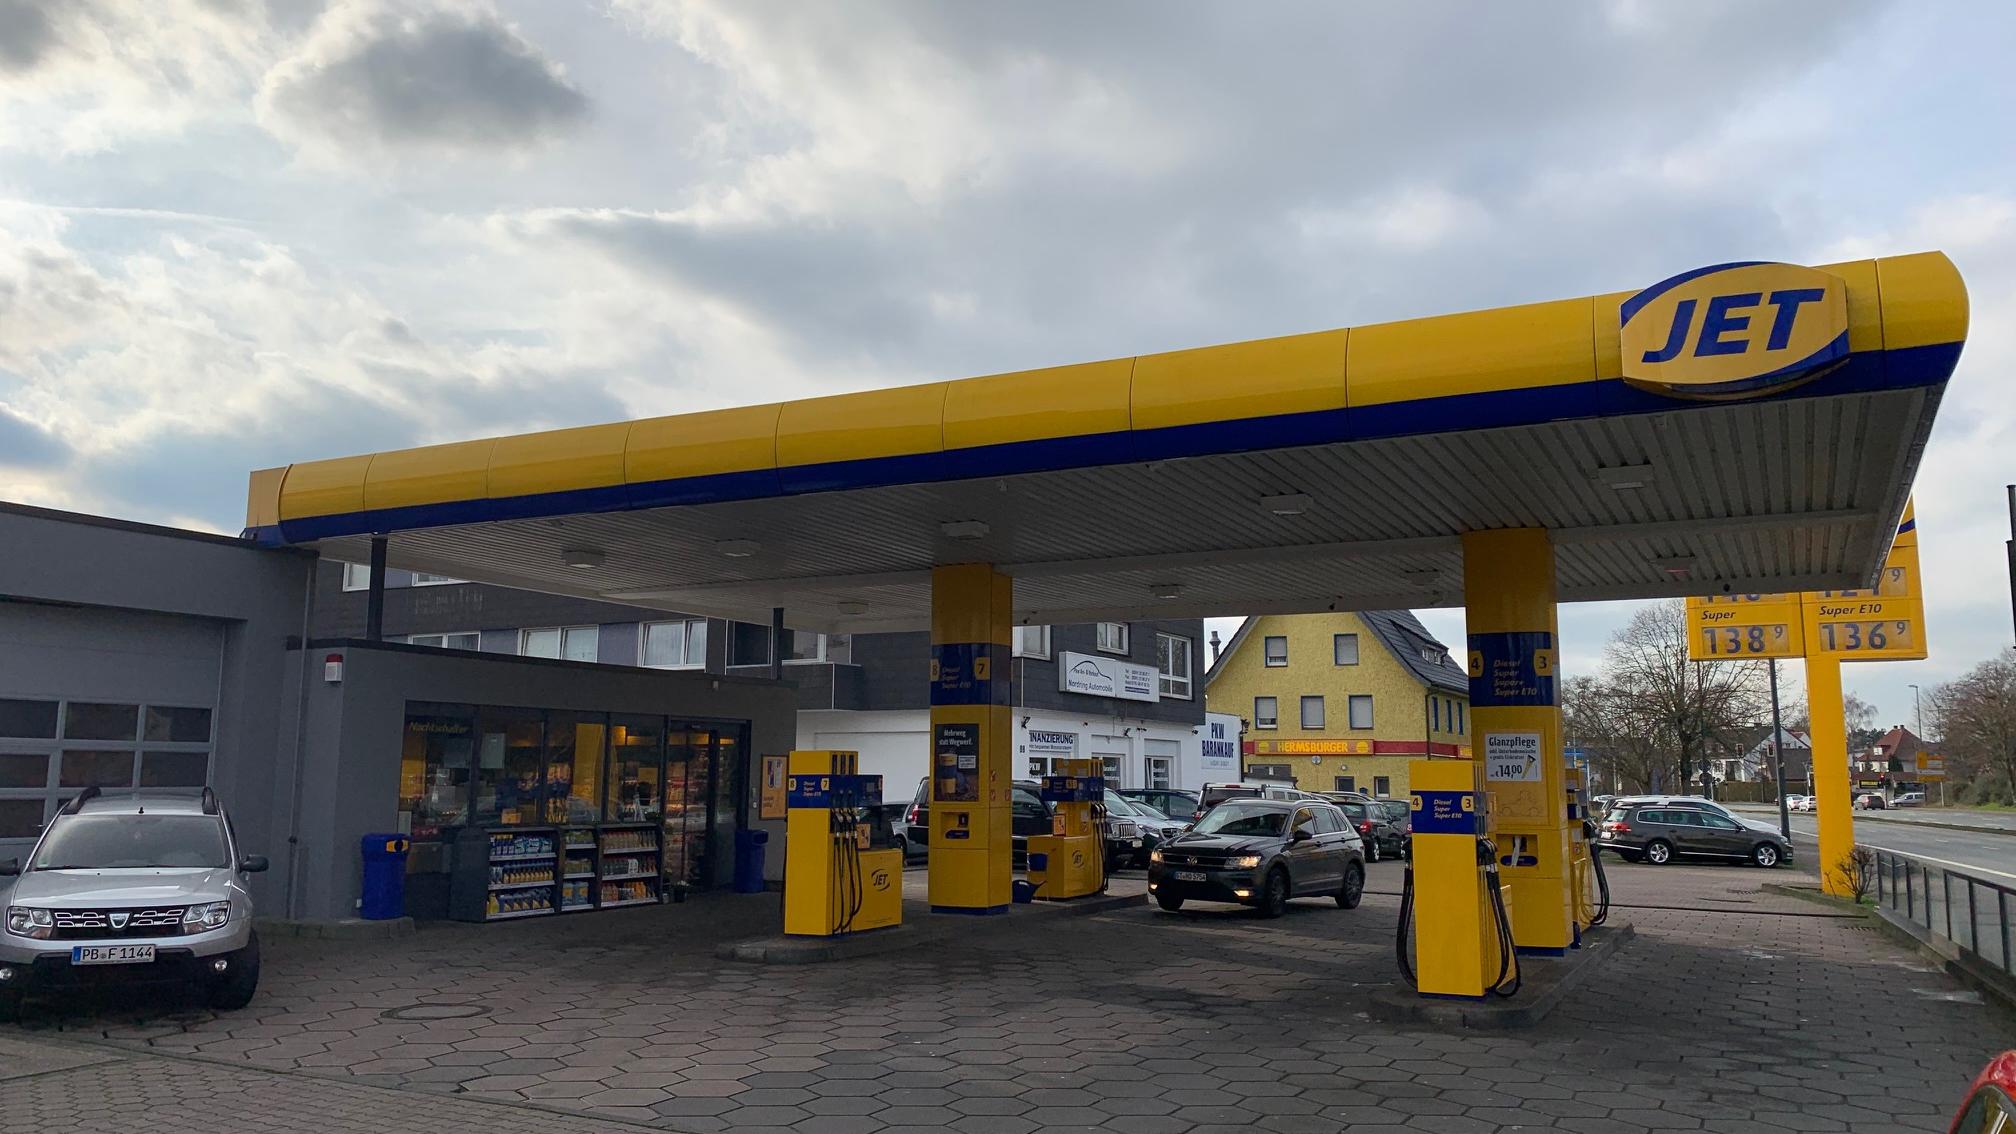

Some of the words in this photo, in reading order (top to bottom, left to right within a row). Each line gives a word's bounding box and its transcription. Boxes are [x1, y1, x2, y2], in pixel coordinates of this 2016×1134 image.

[1641, 288, 1826, 363] JET
[1891, 568, 1901, 582] 9
[1701, 610, 1736, 622] Super
[1819, 605, 1855, 618] Super
[1859, 603, 1882, 614] E10
[1703, 626, 1766, 654] 138
[1774, 625, 1784, 639] 9
[1822, 622, 1887, 651] 136
[1896, 621, 1906, 635] 9
[977, 663, 985, 674] 7
[1471, 657, 1480, 671] 4
[1538, 655, 1547, 670] 3
[1493, 659, 1521, 668] Diesel
[1493, 670, 1520, 678] Super
[1068, 679, 1088, 690] Nordring
[1088, 682, 1113, 693] Automobile
[1494, 689, 1520, 698] Super
[1521, 687, 1538, 696] E10
[943, 729, 966, 738] Mehrweg
[1211, 722, 1225, 739] PKW
[1029, 733, 1074, 744] INANZIERUNG
[1488, 736, 1536, 748] Glanzpflege
[1201, 740, 1234, 758] BARANKAUF
[1277, 740, 1349, 753] HERMSBURGER
[823, 780, 827, 788] 7
[1412, 797, 1419, 807] 4
[1465, 798, 1472, 809] 3
[1433, 805, 1451, 813] Super
[873, 873, 888, 887] JET
[82, 949, 99, 960] PB
[108, 948, 117, 959] F
[119, 946, 152, 959] 1144
